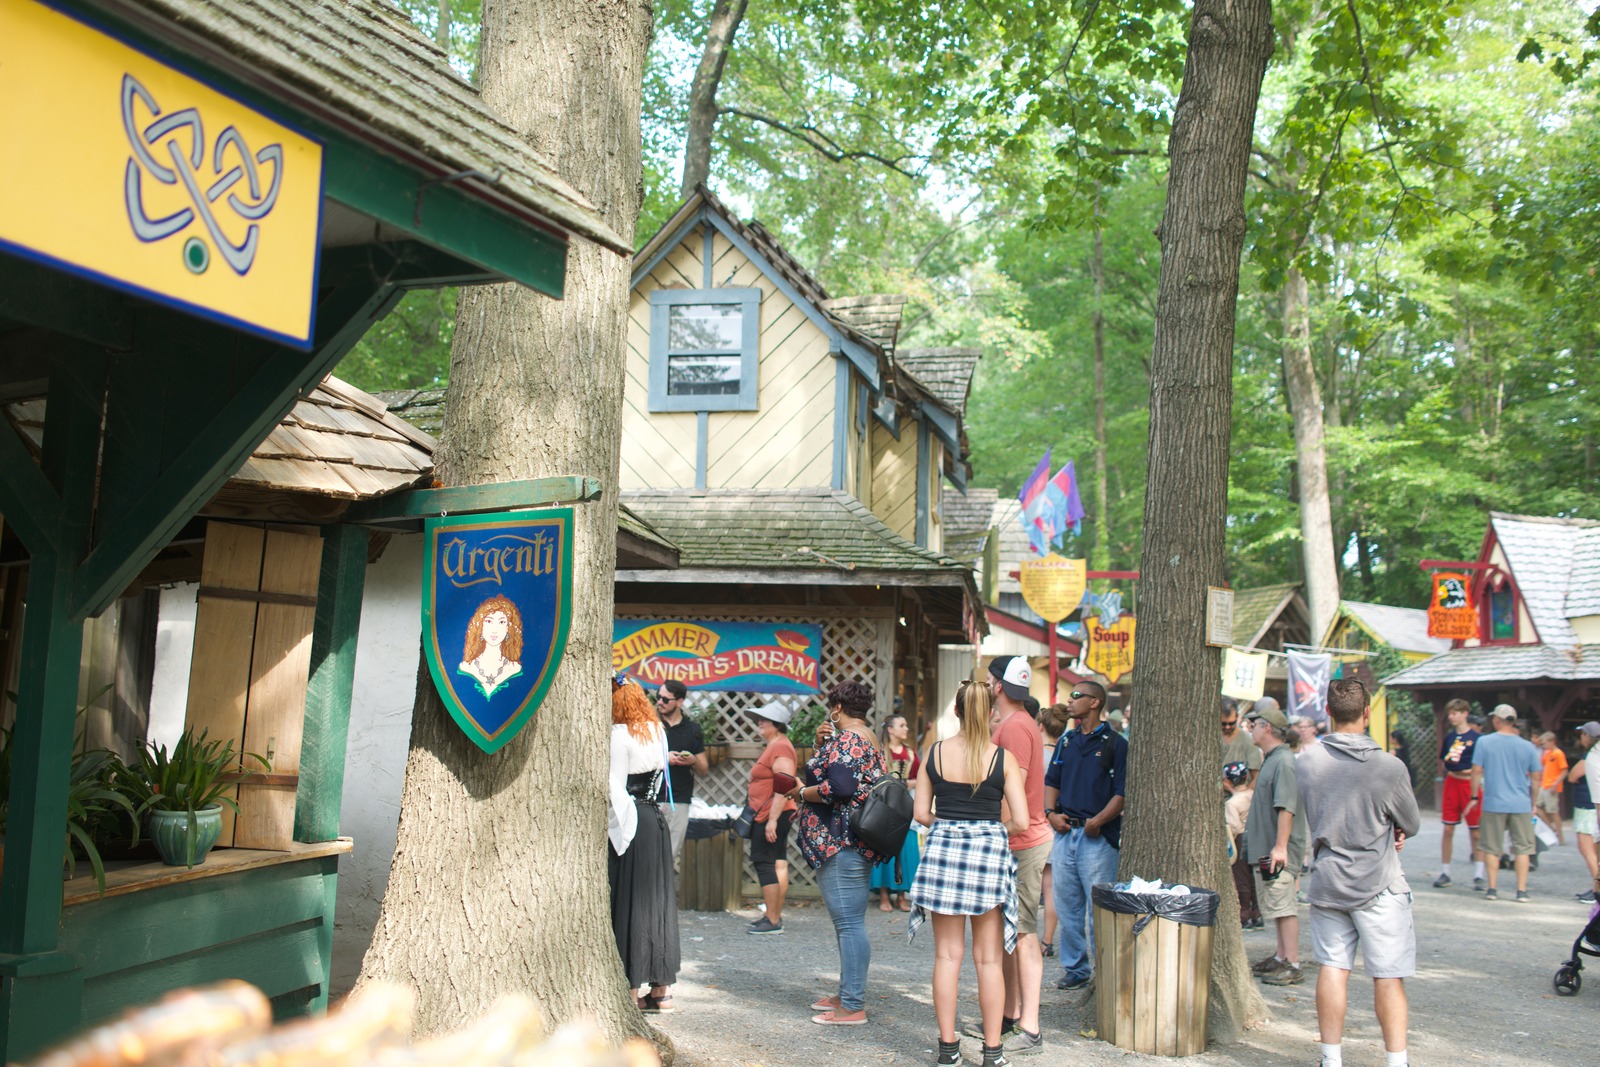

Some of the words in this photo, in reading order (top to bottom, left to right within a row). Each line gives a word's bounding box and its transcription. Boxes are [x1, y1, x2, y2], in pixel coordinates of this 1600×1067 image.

[443, 529, 555, 588] Argenti
[1093, 626, 1129, 648] Soup
[637, 656, 729, 681] KNIGHT'S
[736, 649, 816, 681] DREAM
